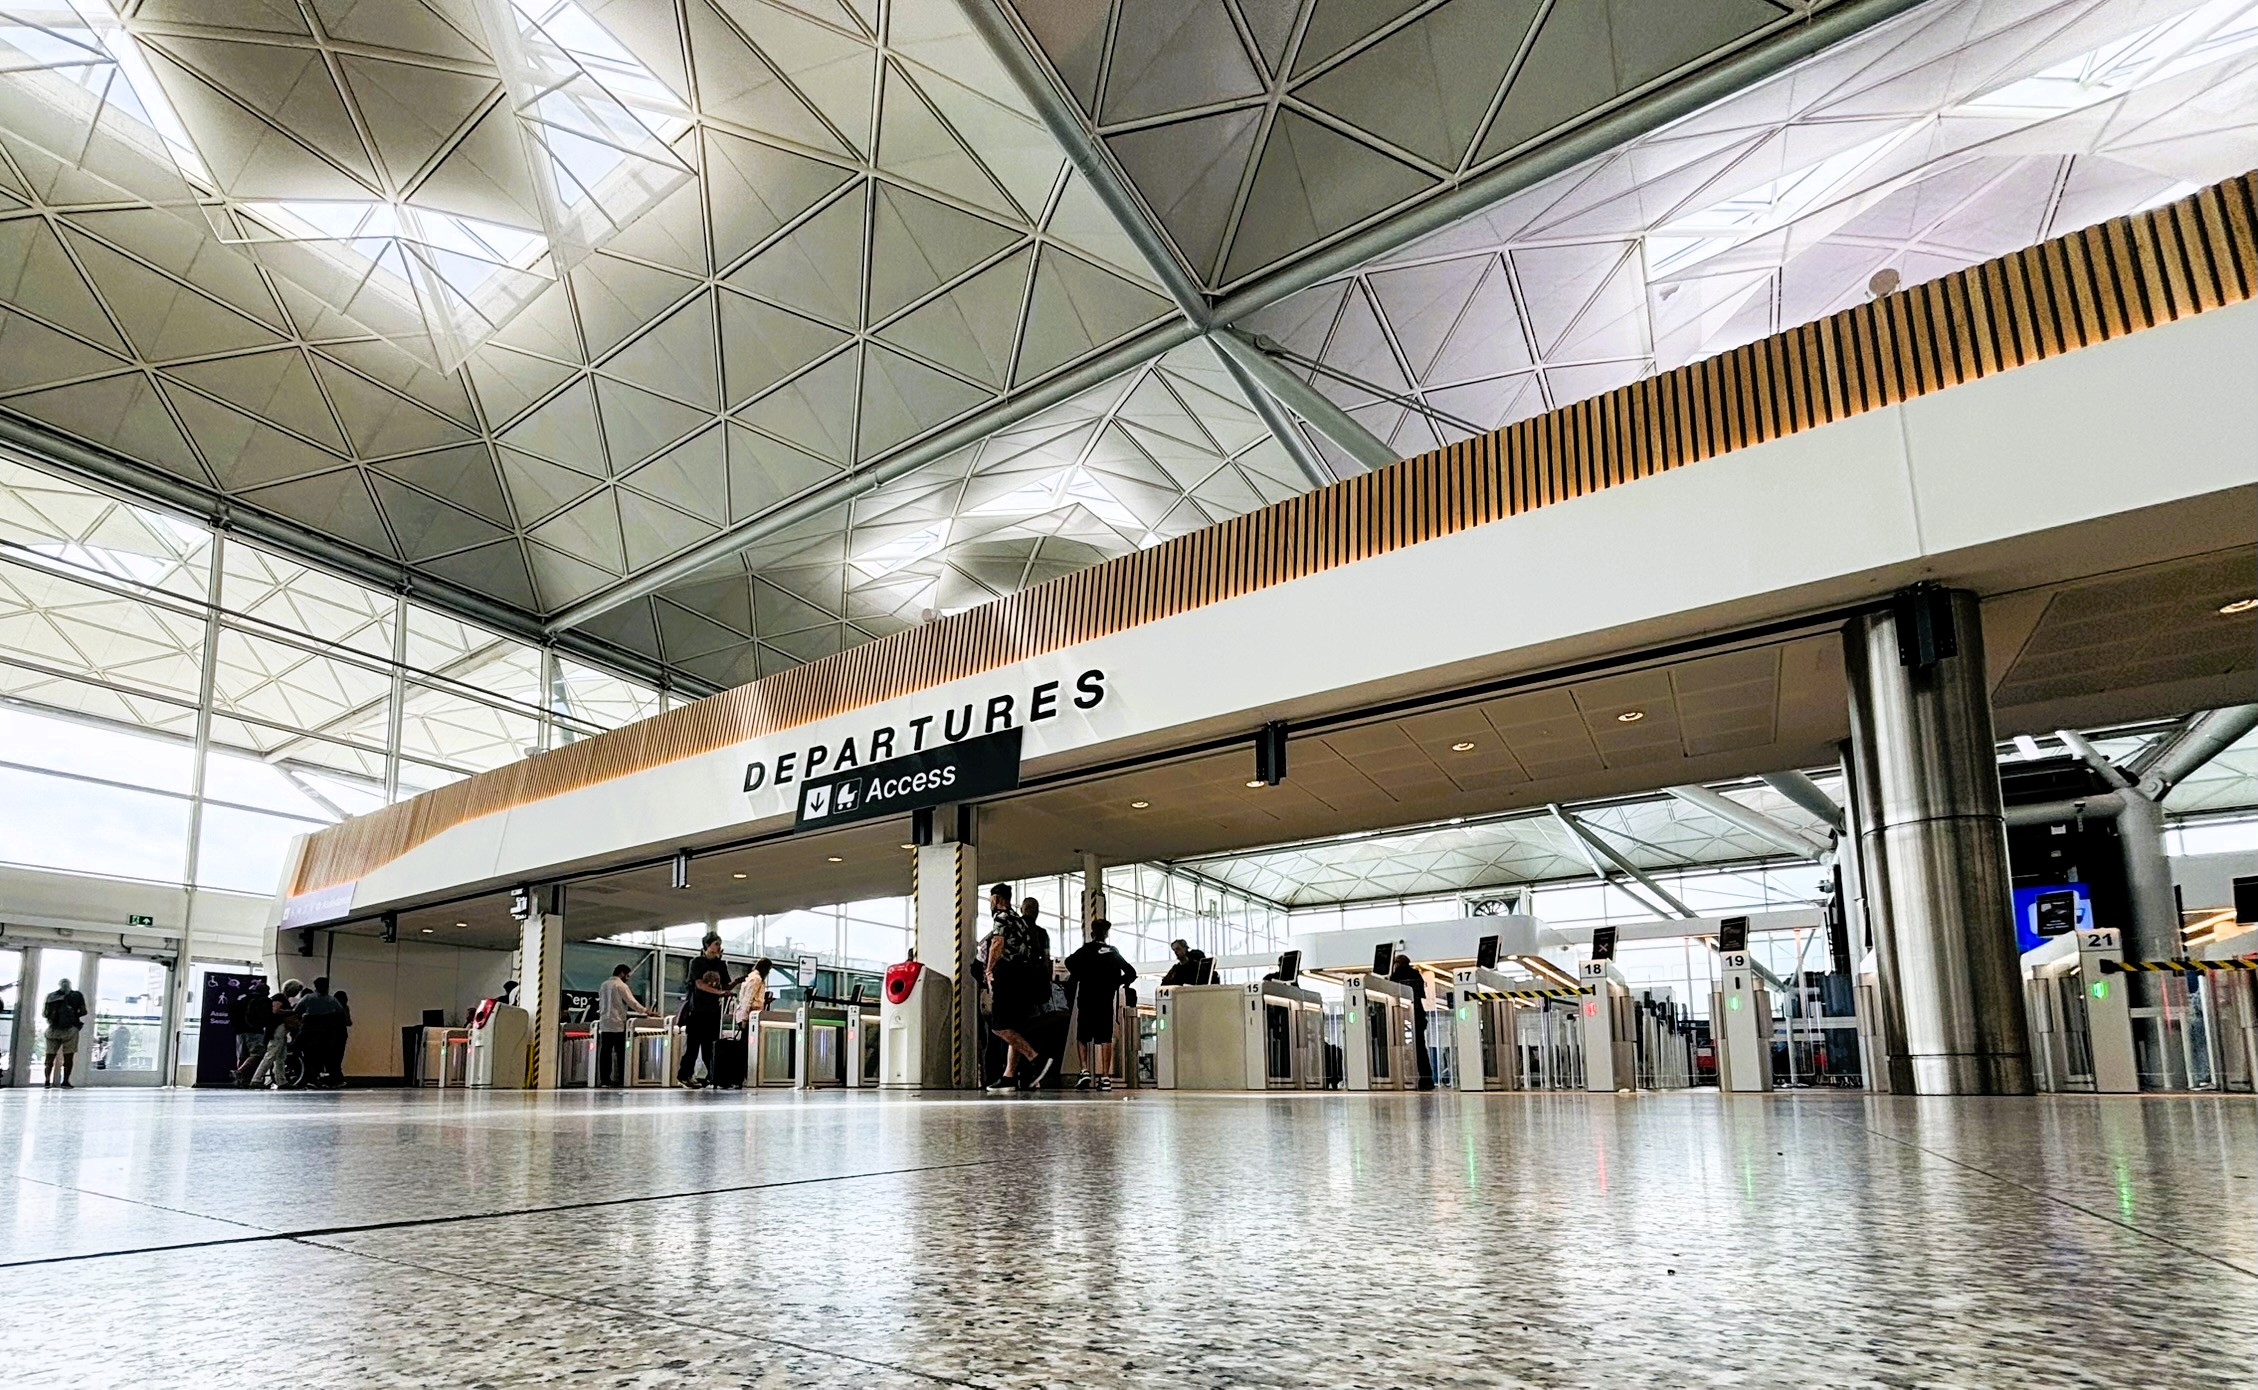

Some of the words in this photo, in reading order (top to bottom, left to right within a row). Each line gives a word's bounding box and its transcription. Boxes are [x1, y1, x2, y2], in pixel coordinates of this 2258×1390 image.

[743, 669, 1105, 792] DEPARTURES
[865, 764, 956, 803] Access
[2088, 933, 2113, 947] 21
[1725, 955, 1745, 967] 19
[1584, 963, 1602, 975] 18
[1346, 977, 1360, 987] 16
[1456, 971, 1472, 982] 17
[1159, 989, 1170, 998] 14
[1246, 983, 1259, 993] 15
